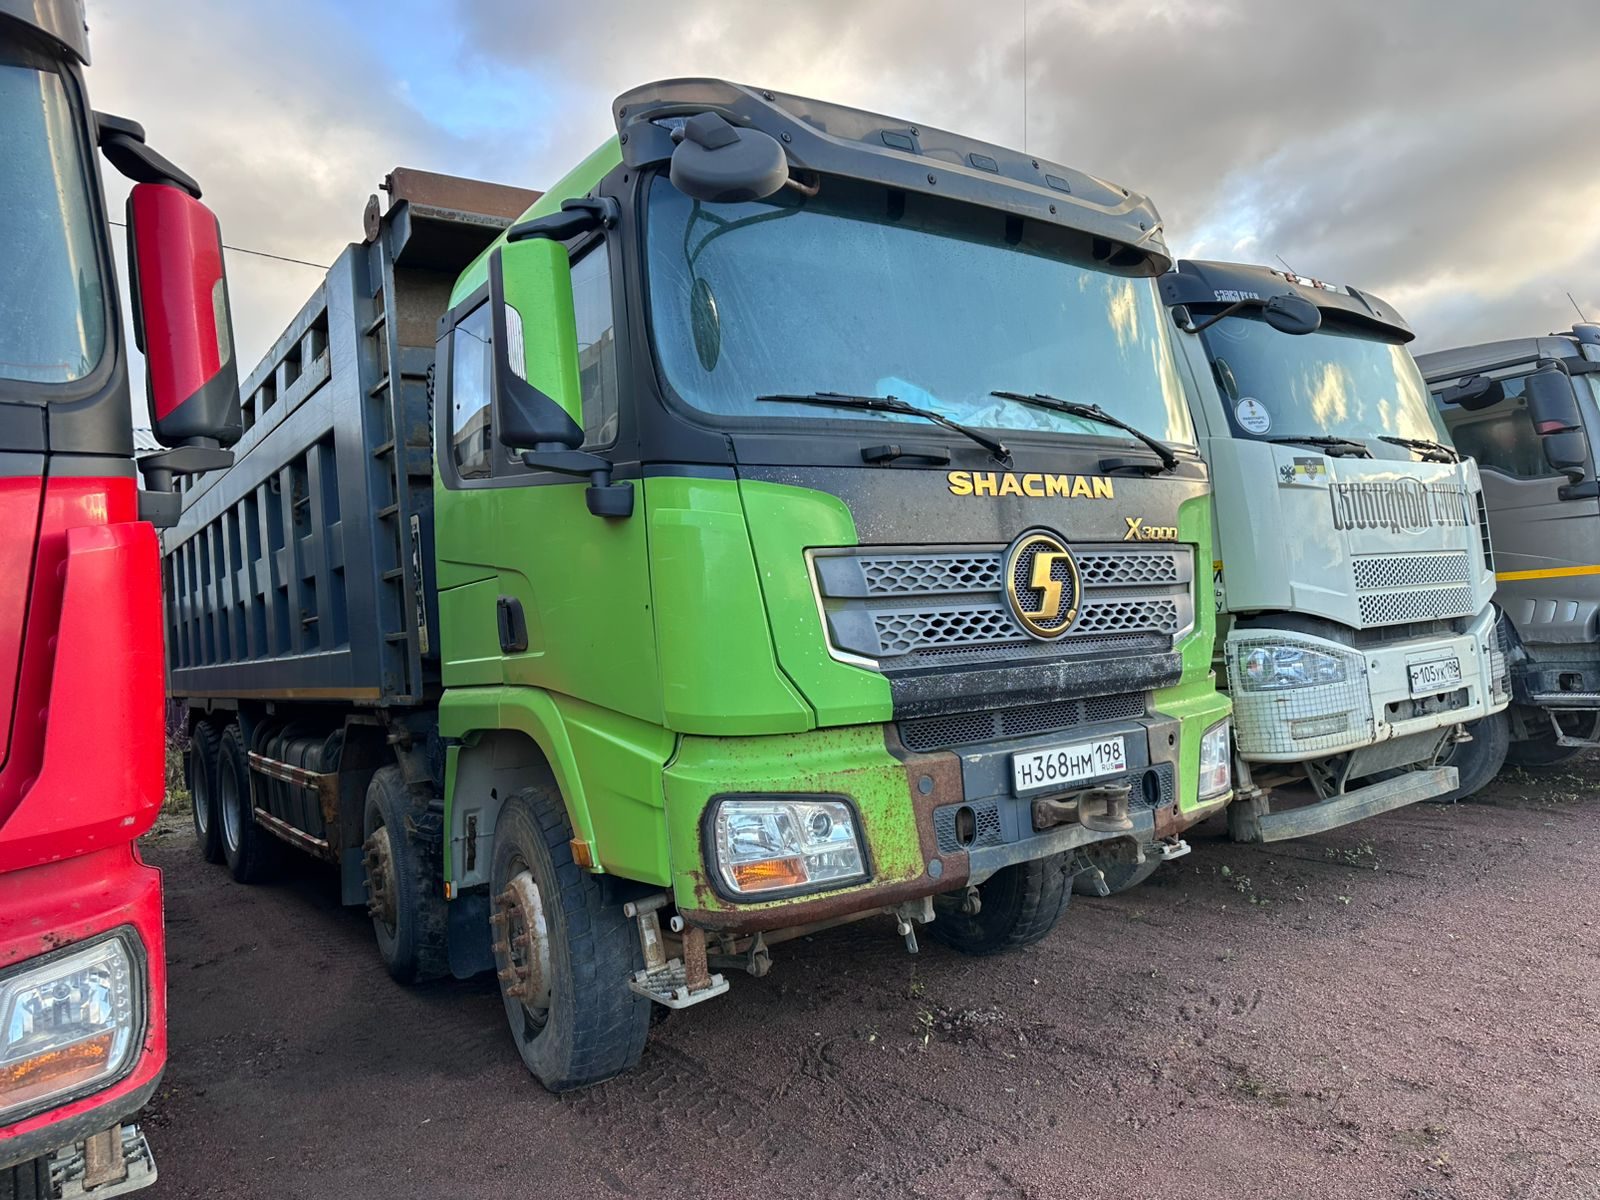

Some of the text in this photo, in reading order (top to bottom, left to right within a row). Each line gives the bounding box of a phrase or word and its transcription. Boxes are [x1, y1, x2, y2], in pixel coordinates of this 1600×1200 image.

[947, 471, 1114, 499] SHACMAN
[1123, 517, 1178, 541] X3000
[1022, 752, 1093, 785] Н368НМ
[1095, 742, 1120, 763] 198
[1101, 763, 1114, 771] RUS
